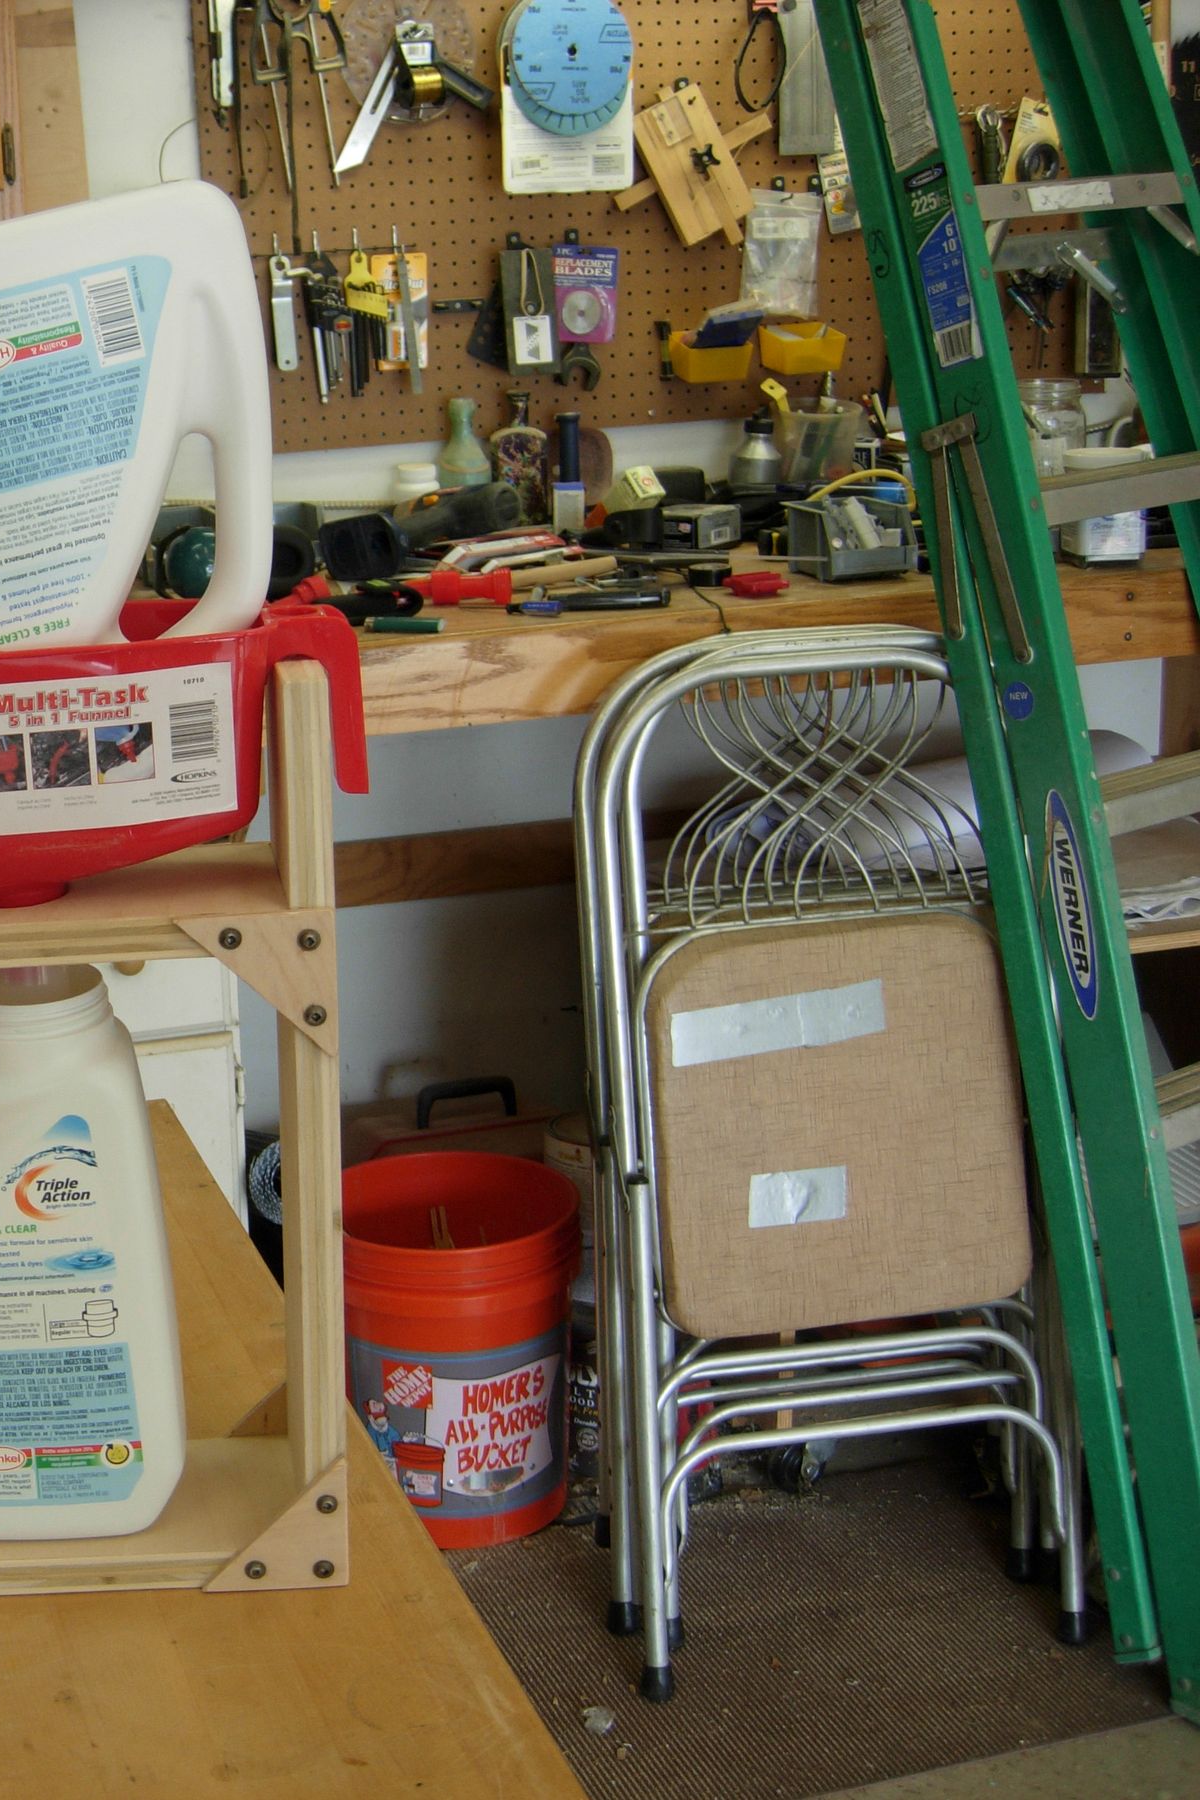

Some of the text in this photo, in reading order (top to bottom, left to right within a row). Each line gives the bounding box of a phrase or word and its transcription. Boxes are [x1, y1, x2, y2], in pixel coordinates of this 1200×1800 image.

[912, 194, 937, 217] 225
[555, 258, 613, 268] REPLACEMENT
[555, 266, 612, 276] BLADES
[18, 323, 75, 346] Responsibility
[39, 337, 67, 352] Quality
[95, 448, 126, 465] CAUTION:
[64, 540, 73, 549] for
[75, 530, 105, 546] Optimized
[45, 542, 61, 554] great
[4, 547, 43, 565] performance
[50, 578, 63, 588] free
[66, 573, 84, 583] 100%
[8, 584, 39, 599] perfumes
[41, 582, 47, 590] of
[9, 586, 78, 611] Dermatologist tested
[24, 600, 73, 620] Hypoallergenic
[33, 625, 39, 636] &
[43, 617, 69, 632] FREE
[183, 677, 205, 685] 10710
[1009, 692, 1028, 701] NEW
[8, 707, 132, 728] 5 in 1 Funnel
[1054, 838, 1089, 974] WERNER
[36, 1178, 78, 1192] Triple
[41, 1190, 90, 1203] Action
[5, 1224, 36, 1233] CLEAR
[67, 1286, 95, 1294] including
[388, 1366, 409, 1384] THE
[384, 1365, 431, 1406] HOME
[462, 1365, 544, 1417] HOMER'S
[401, 1381, 432, 1407] DEPOT
[445, 1398, 548, 1447] ALL-PURPOSE
[458, 1435, 532, 1474] BUCKET
